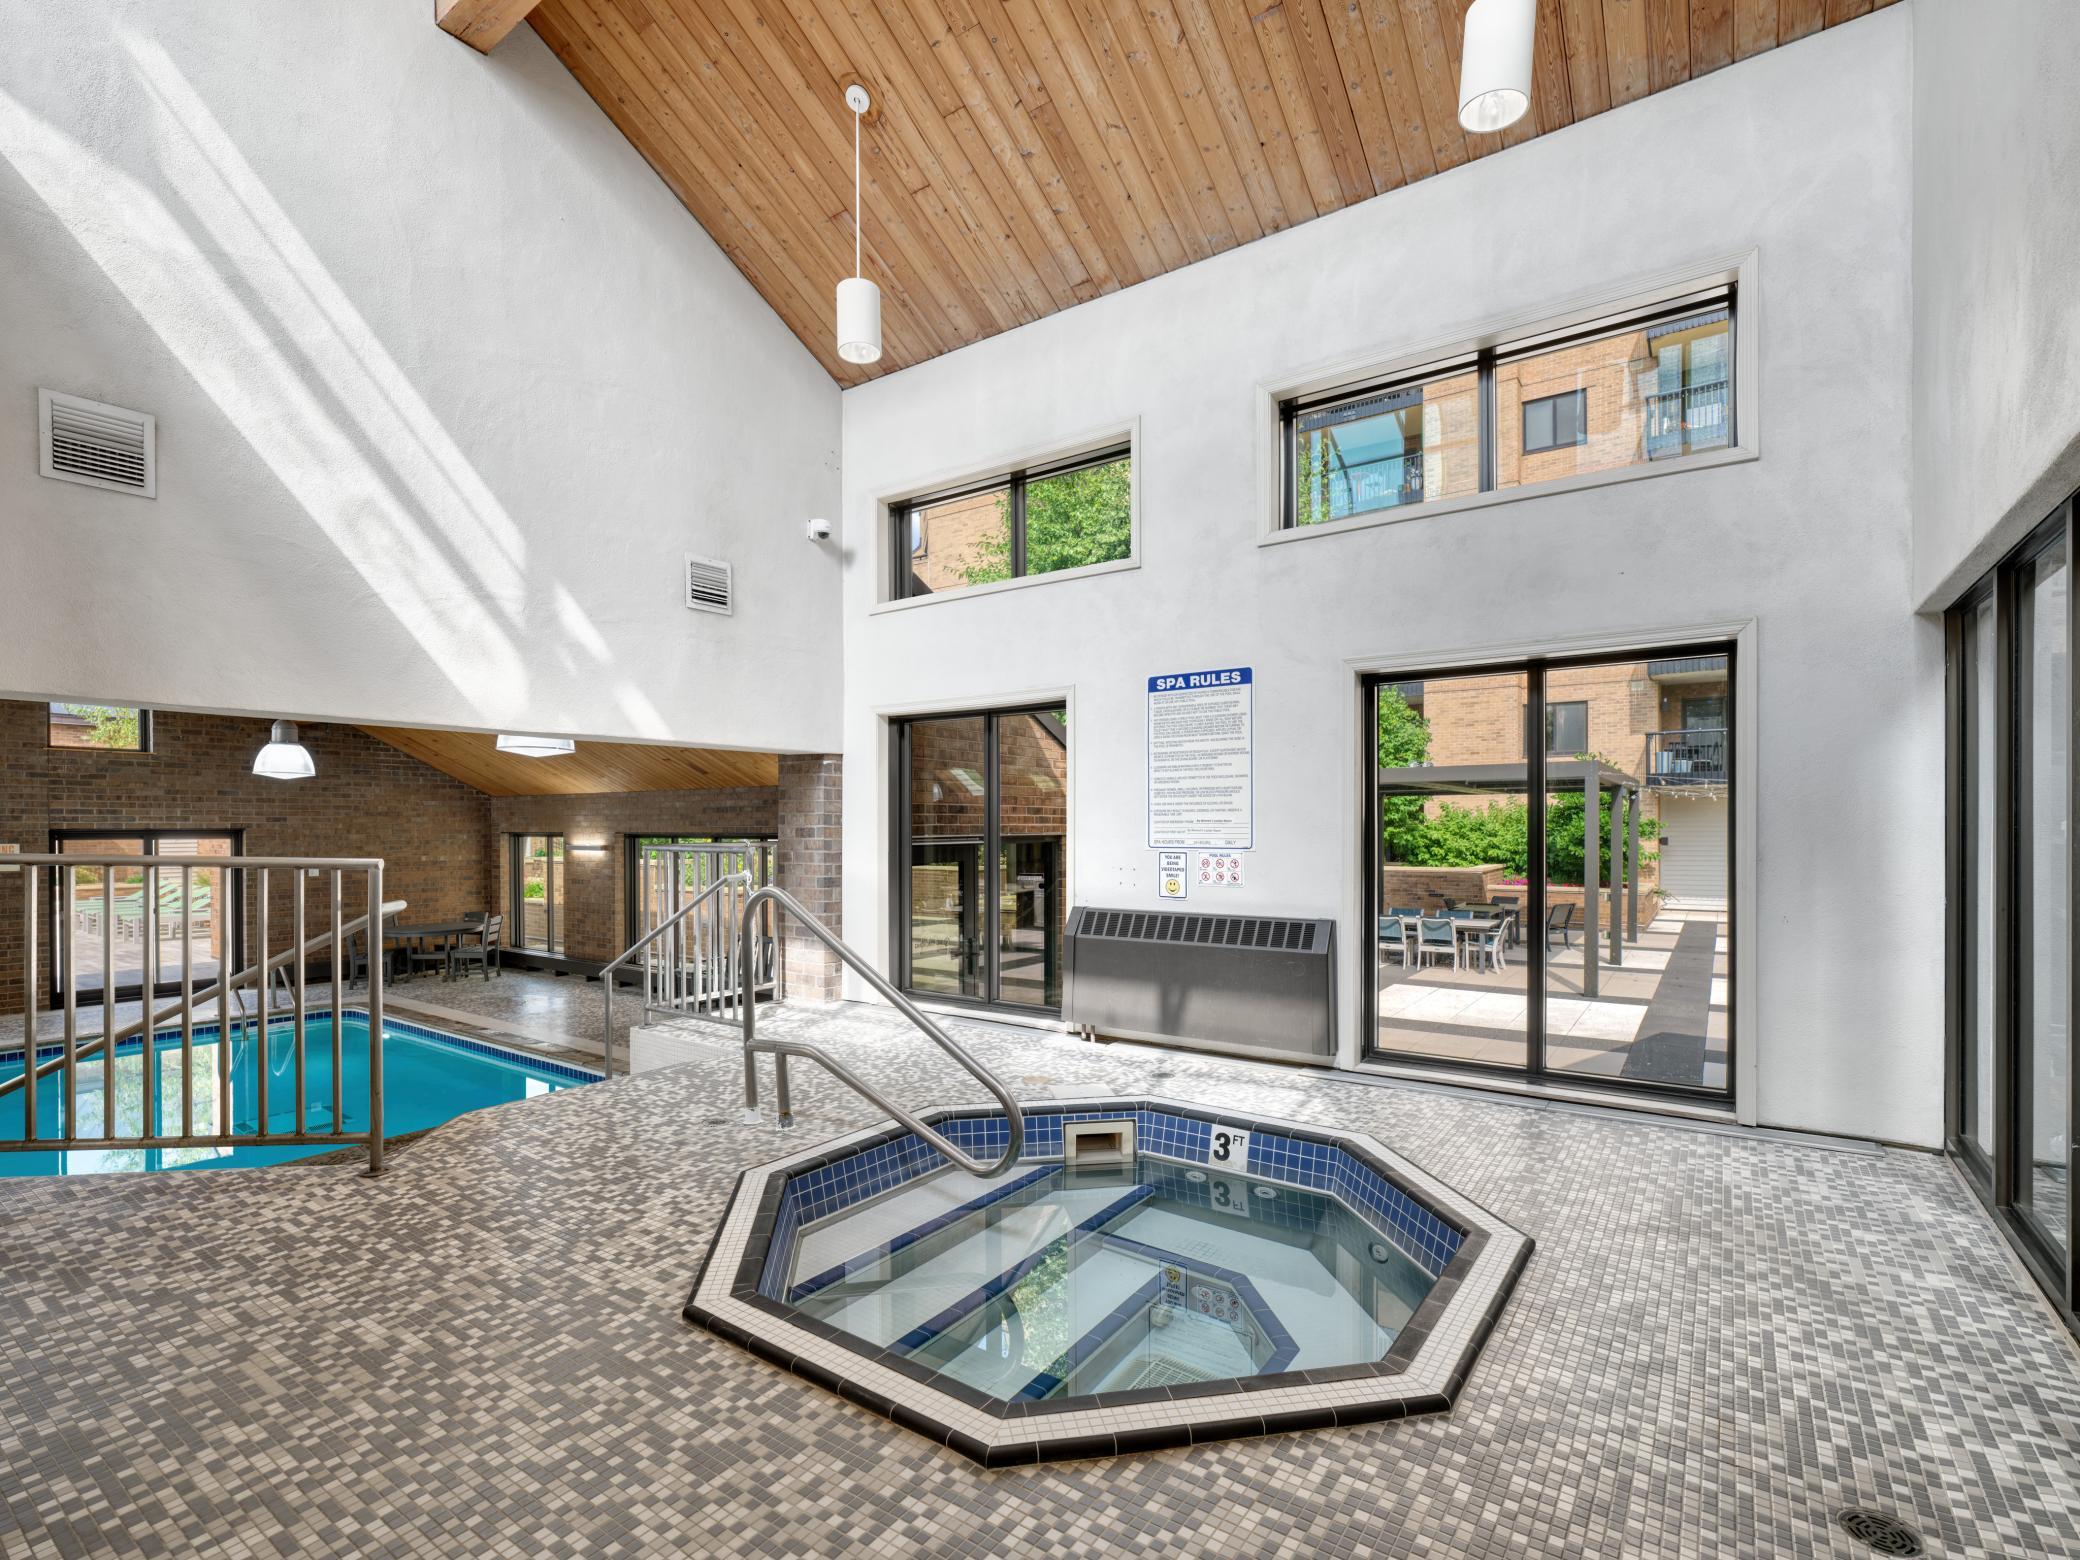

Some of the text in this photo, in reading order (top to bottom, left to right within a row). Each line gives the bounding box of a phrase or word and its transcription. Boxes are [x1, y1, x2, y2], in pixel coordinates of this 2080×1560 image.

[1156, 671, 1241, 690] SPA RULES
[1213, 1132, 1245, 1161] 3 FT
